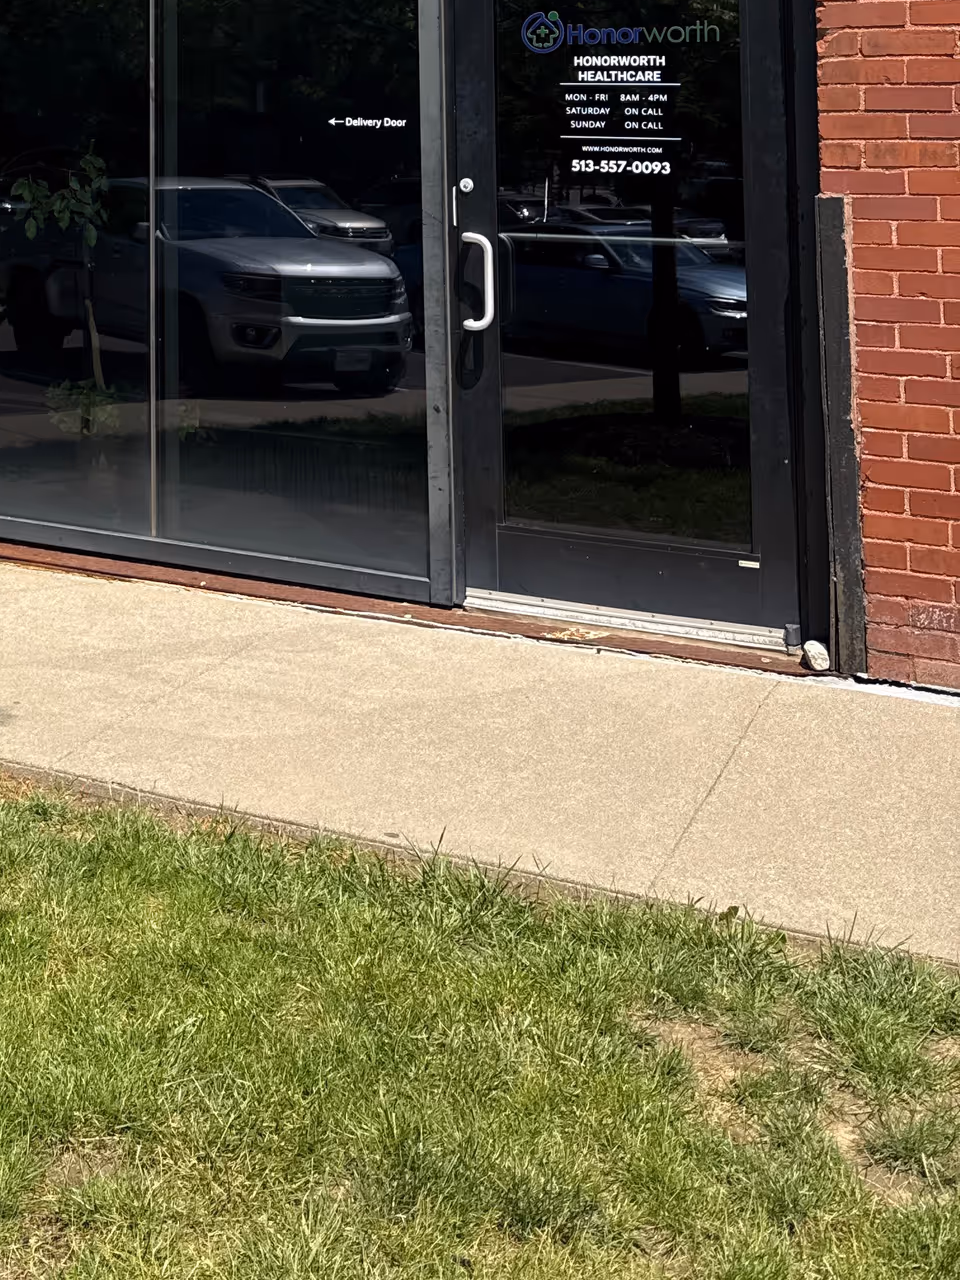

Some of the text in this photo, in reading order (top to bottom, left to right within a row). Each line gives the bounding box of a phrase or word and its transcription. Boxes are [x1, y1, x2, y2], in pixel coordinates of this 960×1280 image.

[567, 20, 720, 45] Honorworth
[573, 56, 666, 66] HONORWORTH
[578, 71, 662, 81] HEALTHCARE
[565, 93, 587, 101] MON
[595, 93, 609, 102] FRI
[620, 94, 640, 102] 8AM
[648, 94, 668, 102] 4PM
[565, 107, 663, 116] SATURDAY ON CALL
[345, 117, 406, 128] Delivery Door
[570, 120, 663, 130] SUNDAY ON CALL
[581, 146, 663, 154] WWW.HONORWORTH.COM
[571, 159, 671, 175] 513-557-0093
